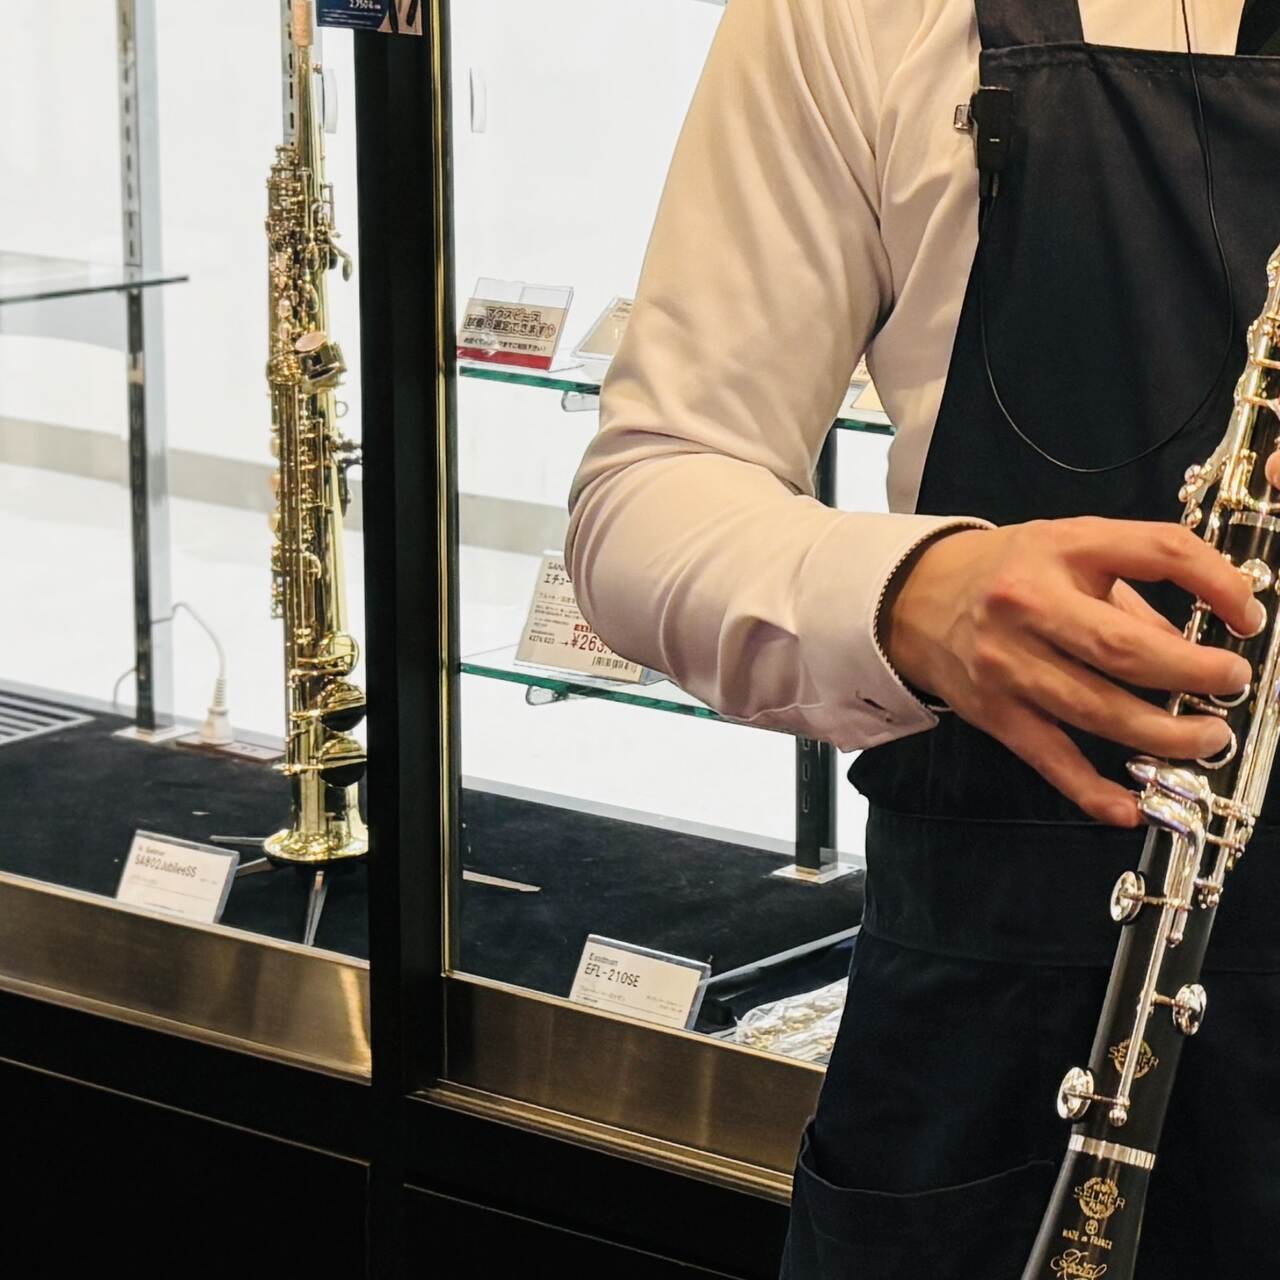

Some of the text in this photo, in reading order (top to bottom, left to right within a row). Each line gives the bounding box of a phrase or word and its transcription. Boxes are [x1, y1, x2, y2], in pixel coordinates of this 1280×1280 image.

[485, 305, 542, 322] マウスピース
[584, 962, 641, 988] EFL-210SE
[1108, 1045, 1160, 1070] SEER
[1073, 1185, 1126, 1210] SELMER
